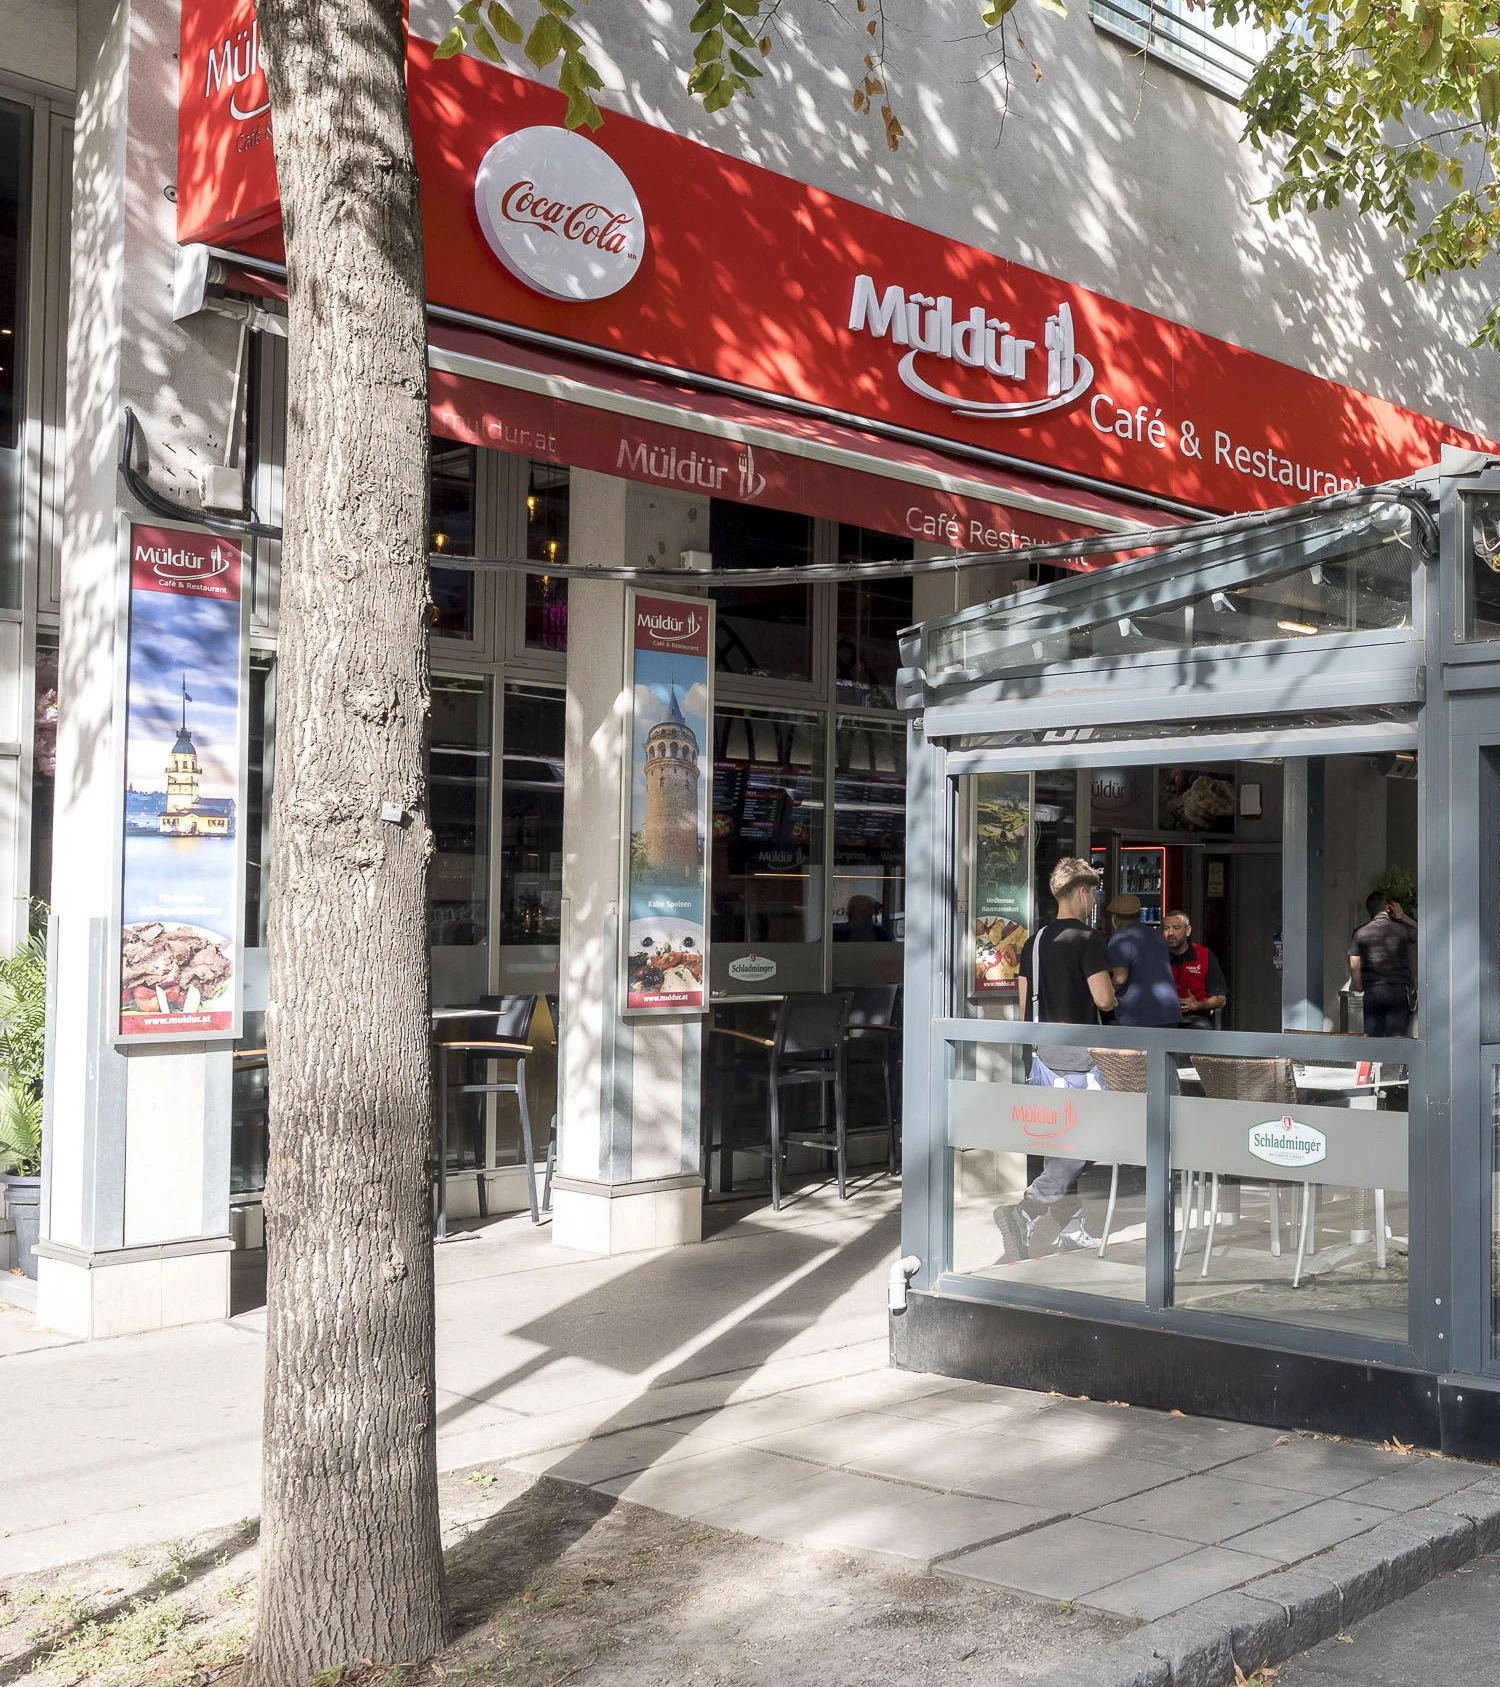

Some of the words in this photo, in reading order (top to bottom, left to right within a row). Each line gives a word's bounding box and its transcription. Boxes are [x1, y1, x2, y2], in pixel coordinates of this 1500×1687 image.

[205, 19, 264, 98] Mül
[501, 180, 635, 254] Coca-Cola
[848, 274, 1036, 382] Müldür
[1090, 394, 1166, 449] Café
[1180, 420, 1203, 460] &
[616, 439, 729, 490] Müldür
[905, 507, 959, 540] Café
[135, 545, 205, 569] Müldür
[158, 579, 177, 589] Café
[178, 581, 185, 589] &
[186, 584, 228, 594] Restaurant
[637, 613, 684, 632] Müldür
[1091, 780, 1126, 799] üldür
[666, 900, 692, 910] Speisen
[731, 964, 774, 974] Schladminger
[643, 993, 689, 1003] www.muldur.at
[1254, 1133, 1321, 1154] Schladminger
